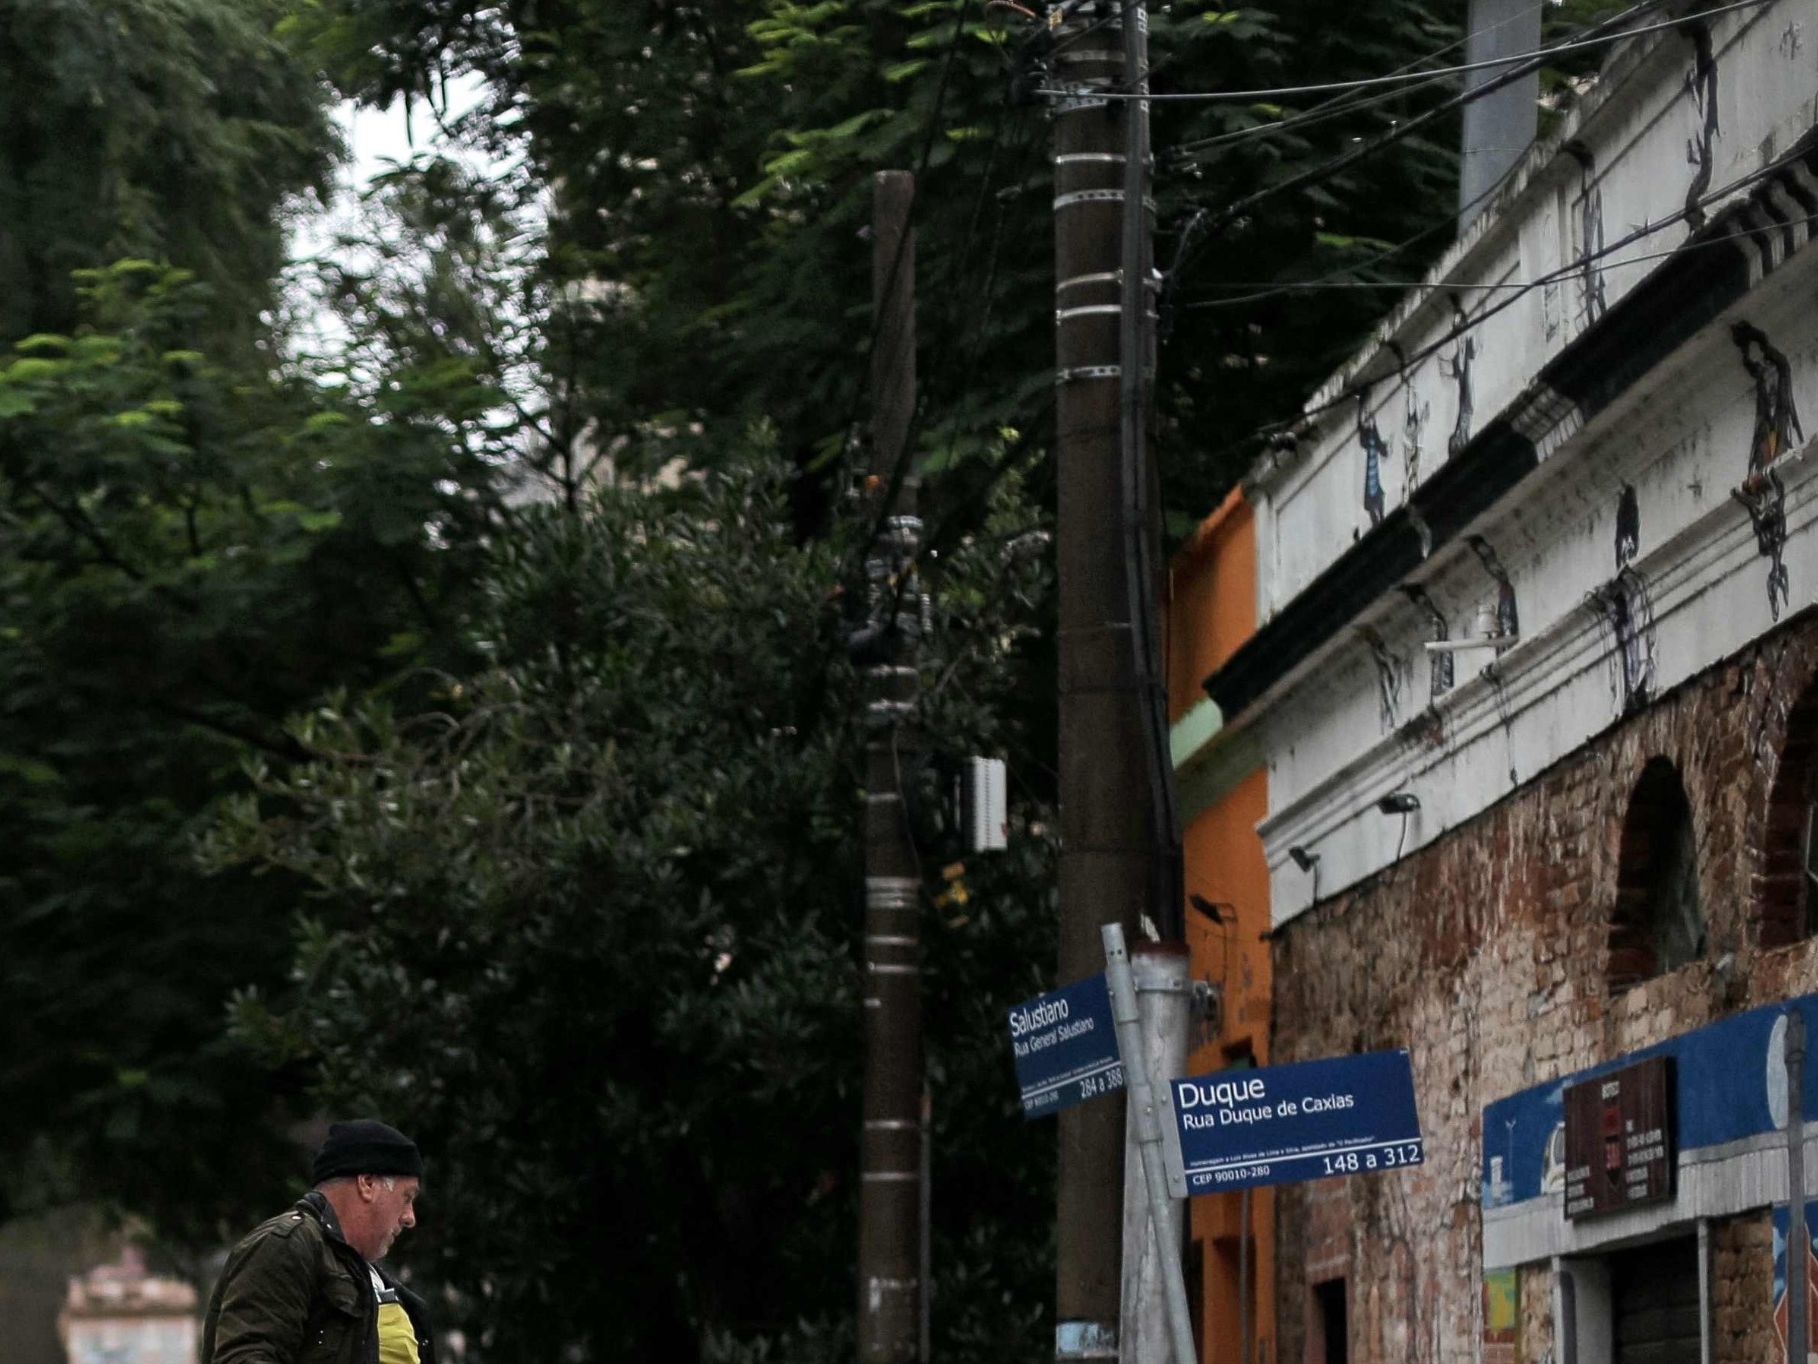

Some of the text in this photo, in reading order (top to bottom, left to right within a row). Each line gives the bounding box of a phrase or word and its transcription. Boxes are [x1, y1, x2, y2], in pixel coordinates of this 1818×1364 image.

[1010, 998, 1069, 1037] Salustiano
[1014, 1041, 1029, 1058] Rua
[1058, 1017, 1095, 1042] Salustiano
[1080, 1078, 1097, 1099] 284
[1099, 1078, 1105, 1092] a
[1178, 1078, 1266, 1109] Duque
[1183, 1093, 1355, 1130] Rua Duque de Caxias
[1192, 1165, 1270, 1185] CEP 90010-280
[1324, 1144, 1421, 1175] 148 a 312
